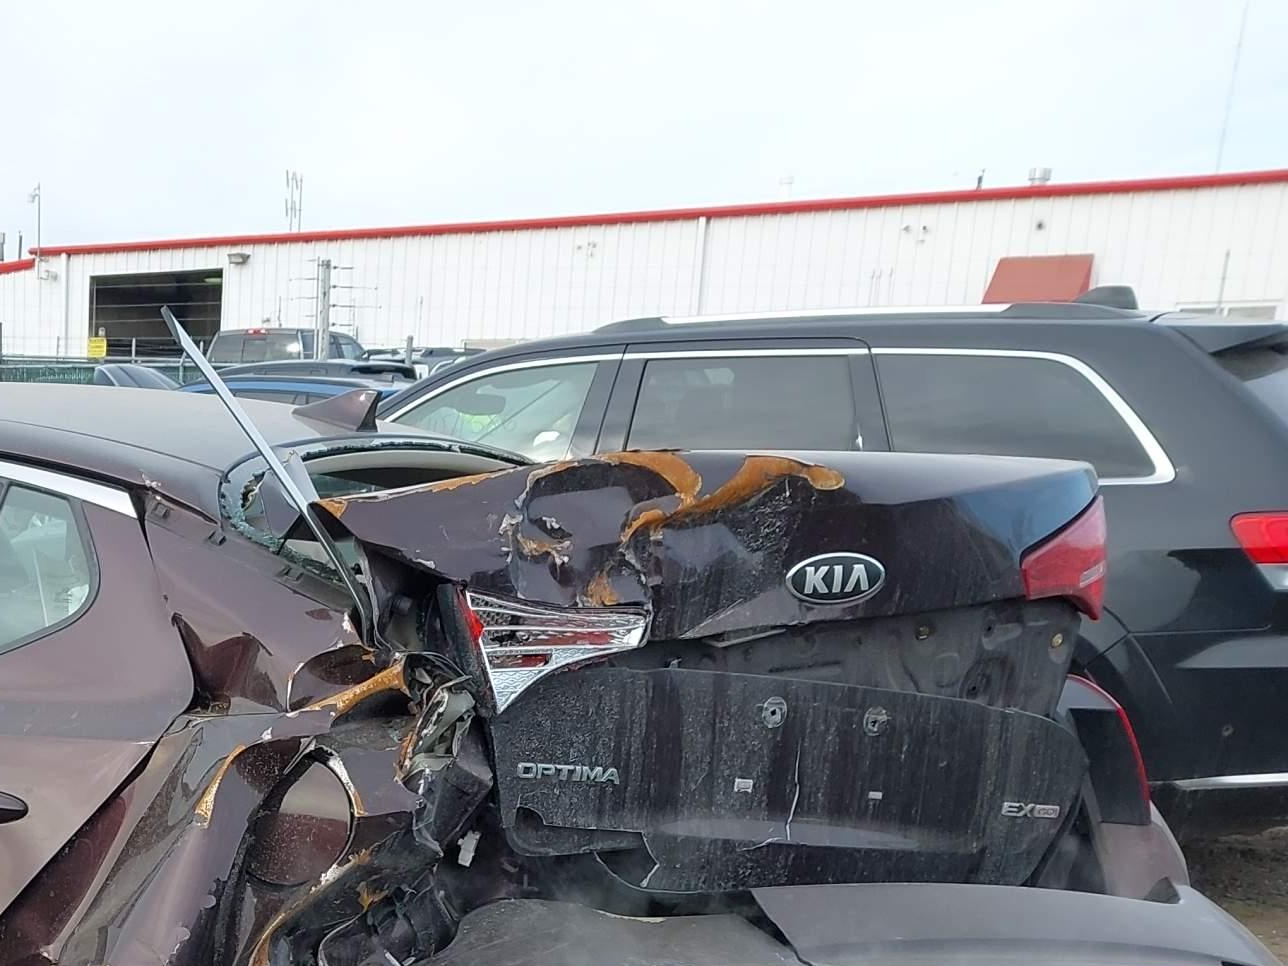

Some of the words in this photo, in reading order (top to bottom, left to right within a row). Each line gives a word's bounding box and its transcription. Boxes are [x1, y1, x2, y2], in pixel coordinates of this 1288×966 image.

[803, 564, 869, 594] KIA
[516, 762, 620, 785] OPTIMA
[1001, 801, 1035, 817] EX
